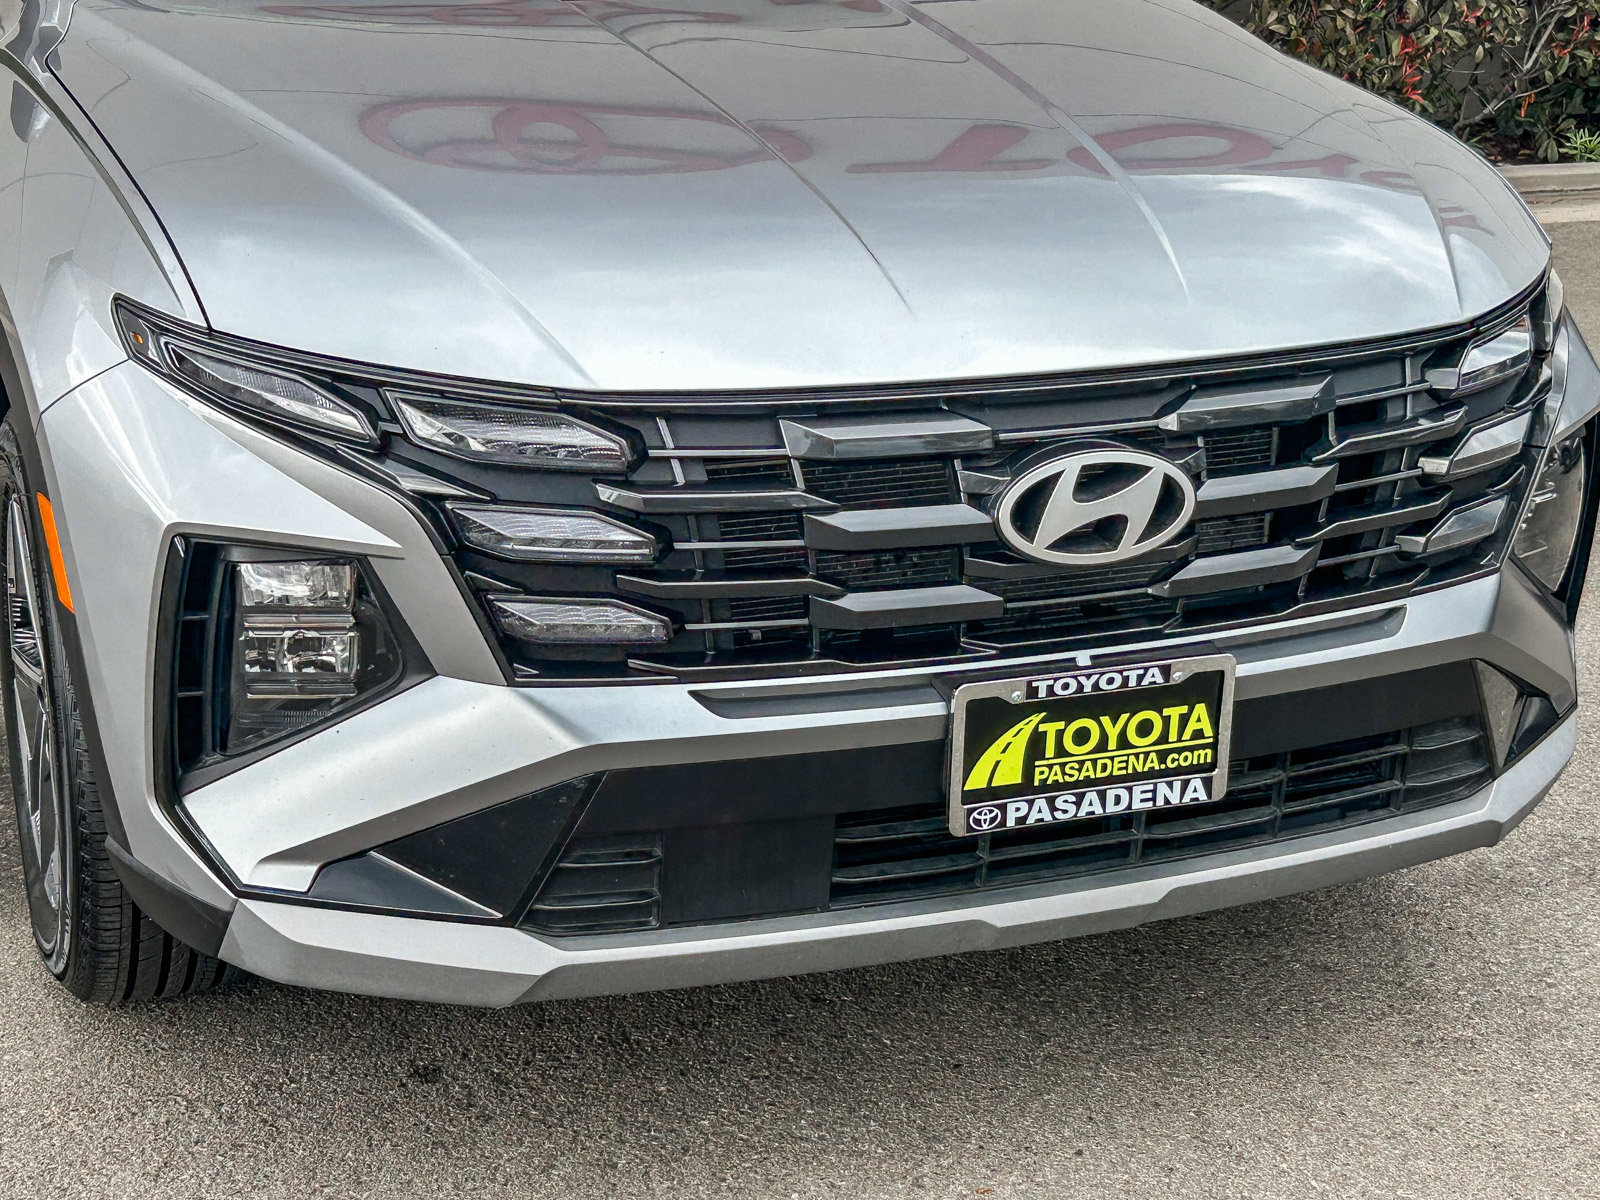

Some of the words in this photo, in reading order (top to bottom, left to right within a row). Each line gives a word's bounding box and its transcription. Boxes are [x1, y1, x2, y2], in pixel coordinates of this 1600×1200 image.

[1032, 667, 1164, 698] TOYOTA
[1038, 703, 1213, 758] TOYOTA
[1034, 748, 1212, 786] PASADENA.com
[1006, 778, 1208, 827] PASADENA
